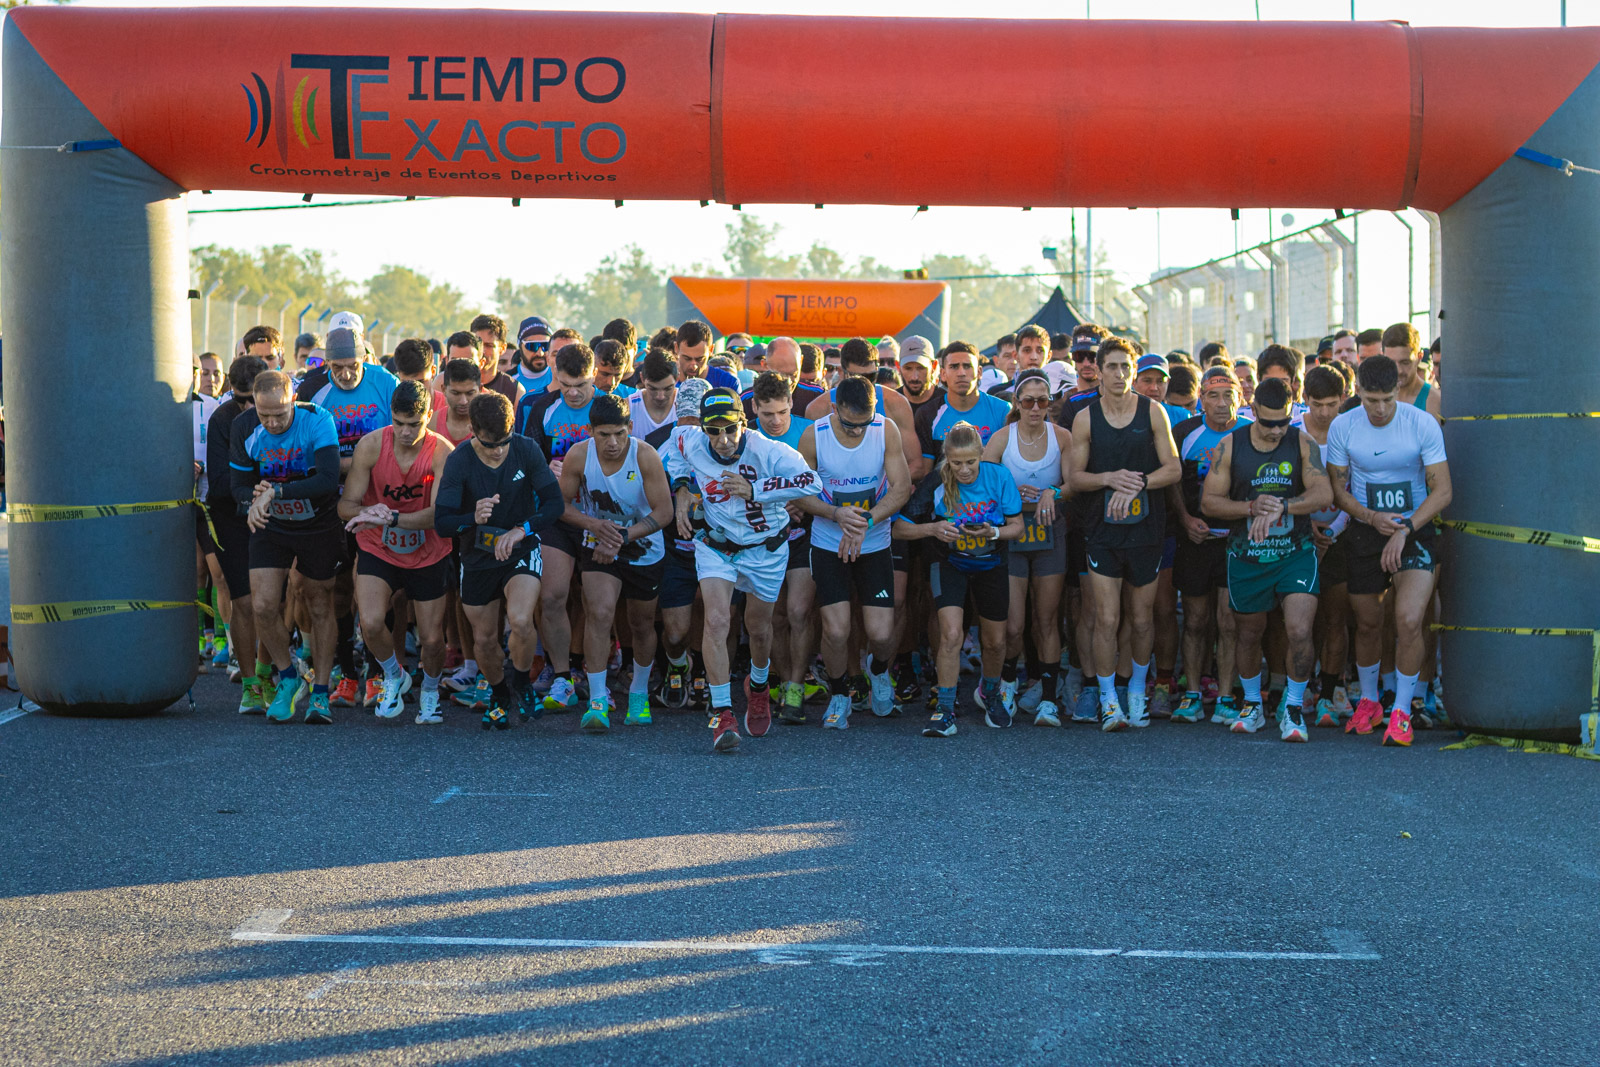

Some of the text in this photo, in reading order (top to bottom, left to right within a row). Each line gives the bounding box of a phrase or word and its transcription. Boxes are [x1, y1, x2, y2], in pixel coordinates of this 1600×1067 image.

[351, 74, 628, 164] EXACTO
[249, 163, 617, 183] Cronometraje de Eventos Deportivos
[1282, 463, 1290, 474] 3
[830, 475, 878, 486] RUNNEA
[1251, 476, 1293, 486] EGUSQUIZA
[1376, 489, 1405, 508] 106
[274, 500, 304, 515] 359
[389, 531, 417, 547] 313
[956, 534, 986, 551] 650
